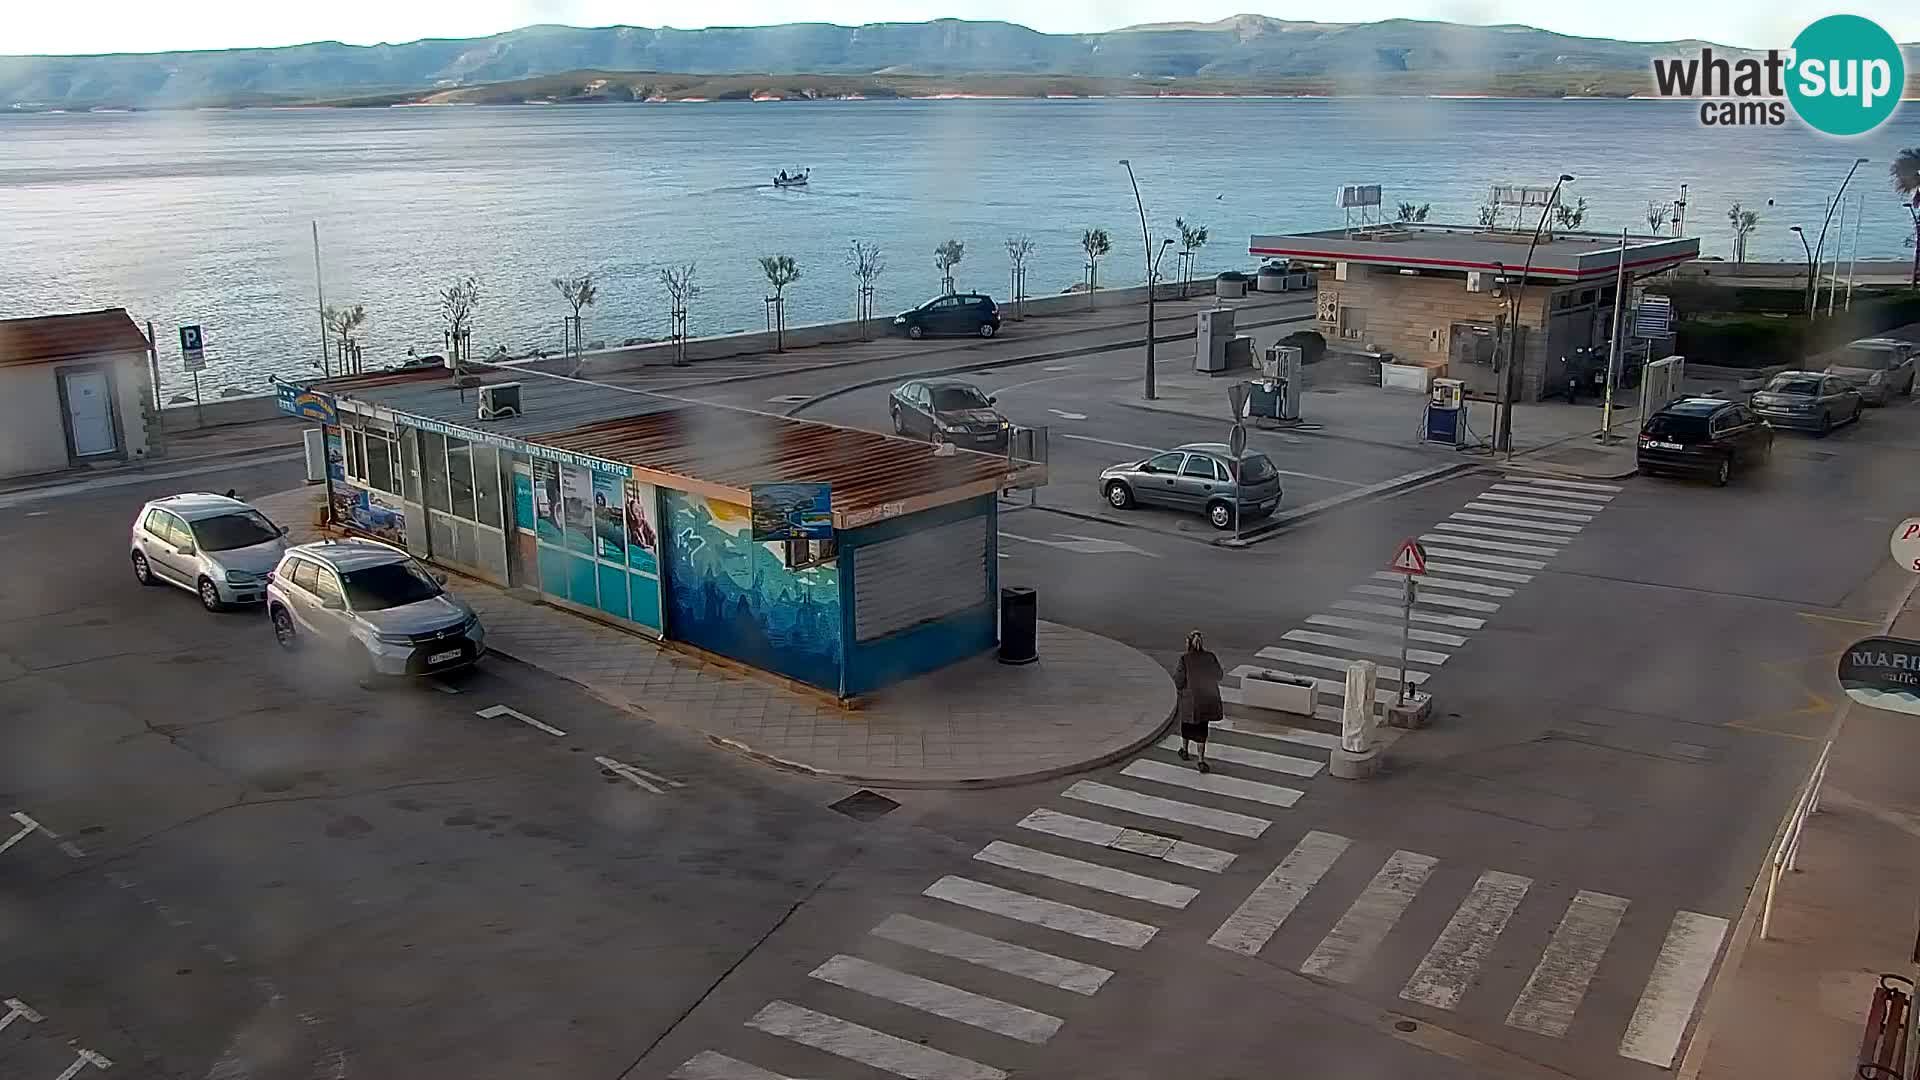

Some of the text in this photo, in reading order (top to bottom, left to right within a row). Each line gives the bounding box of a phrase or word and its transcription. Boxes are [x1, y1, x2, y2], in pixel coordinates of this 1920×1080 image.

[185, 329, 197, 347] P
[526, 444, 540, 456] BUS
[541, 449, 573, 464] STATION
[575, 456, 601, 470] TICKET
[602, 463, 628, 476] OFFICE
[1902, 524, 1920, 539] P
[1851, 652, 1920, 671] MARI
